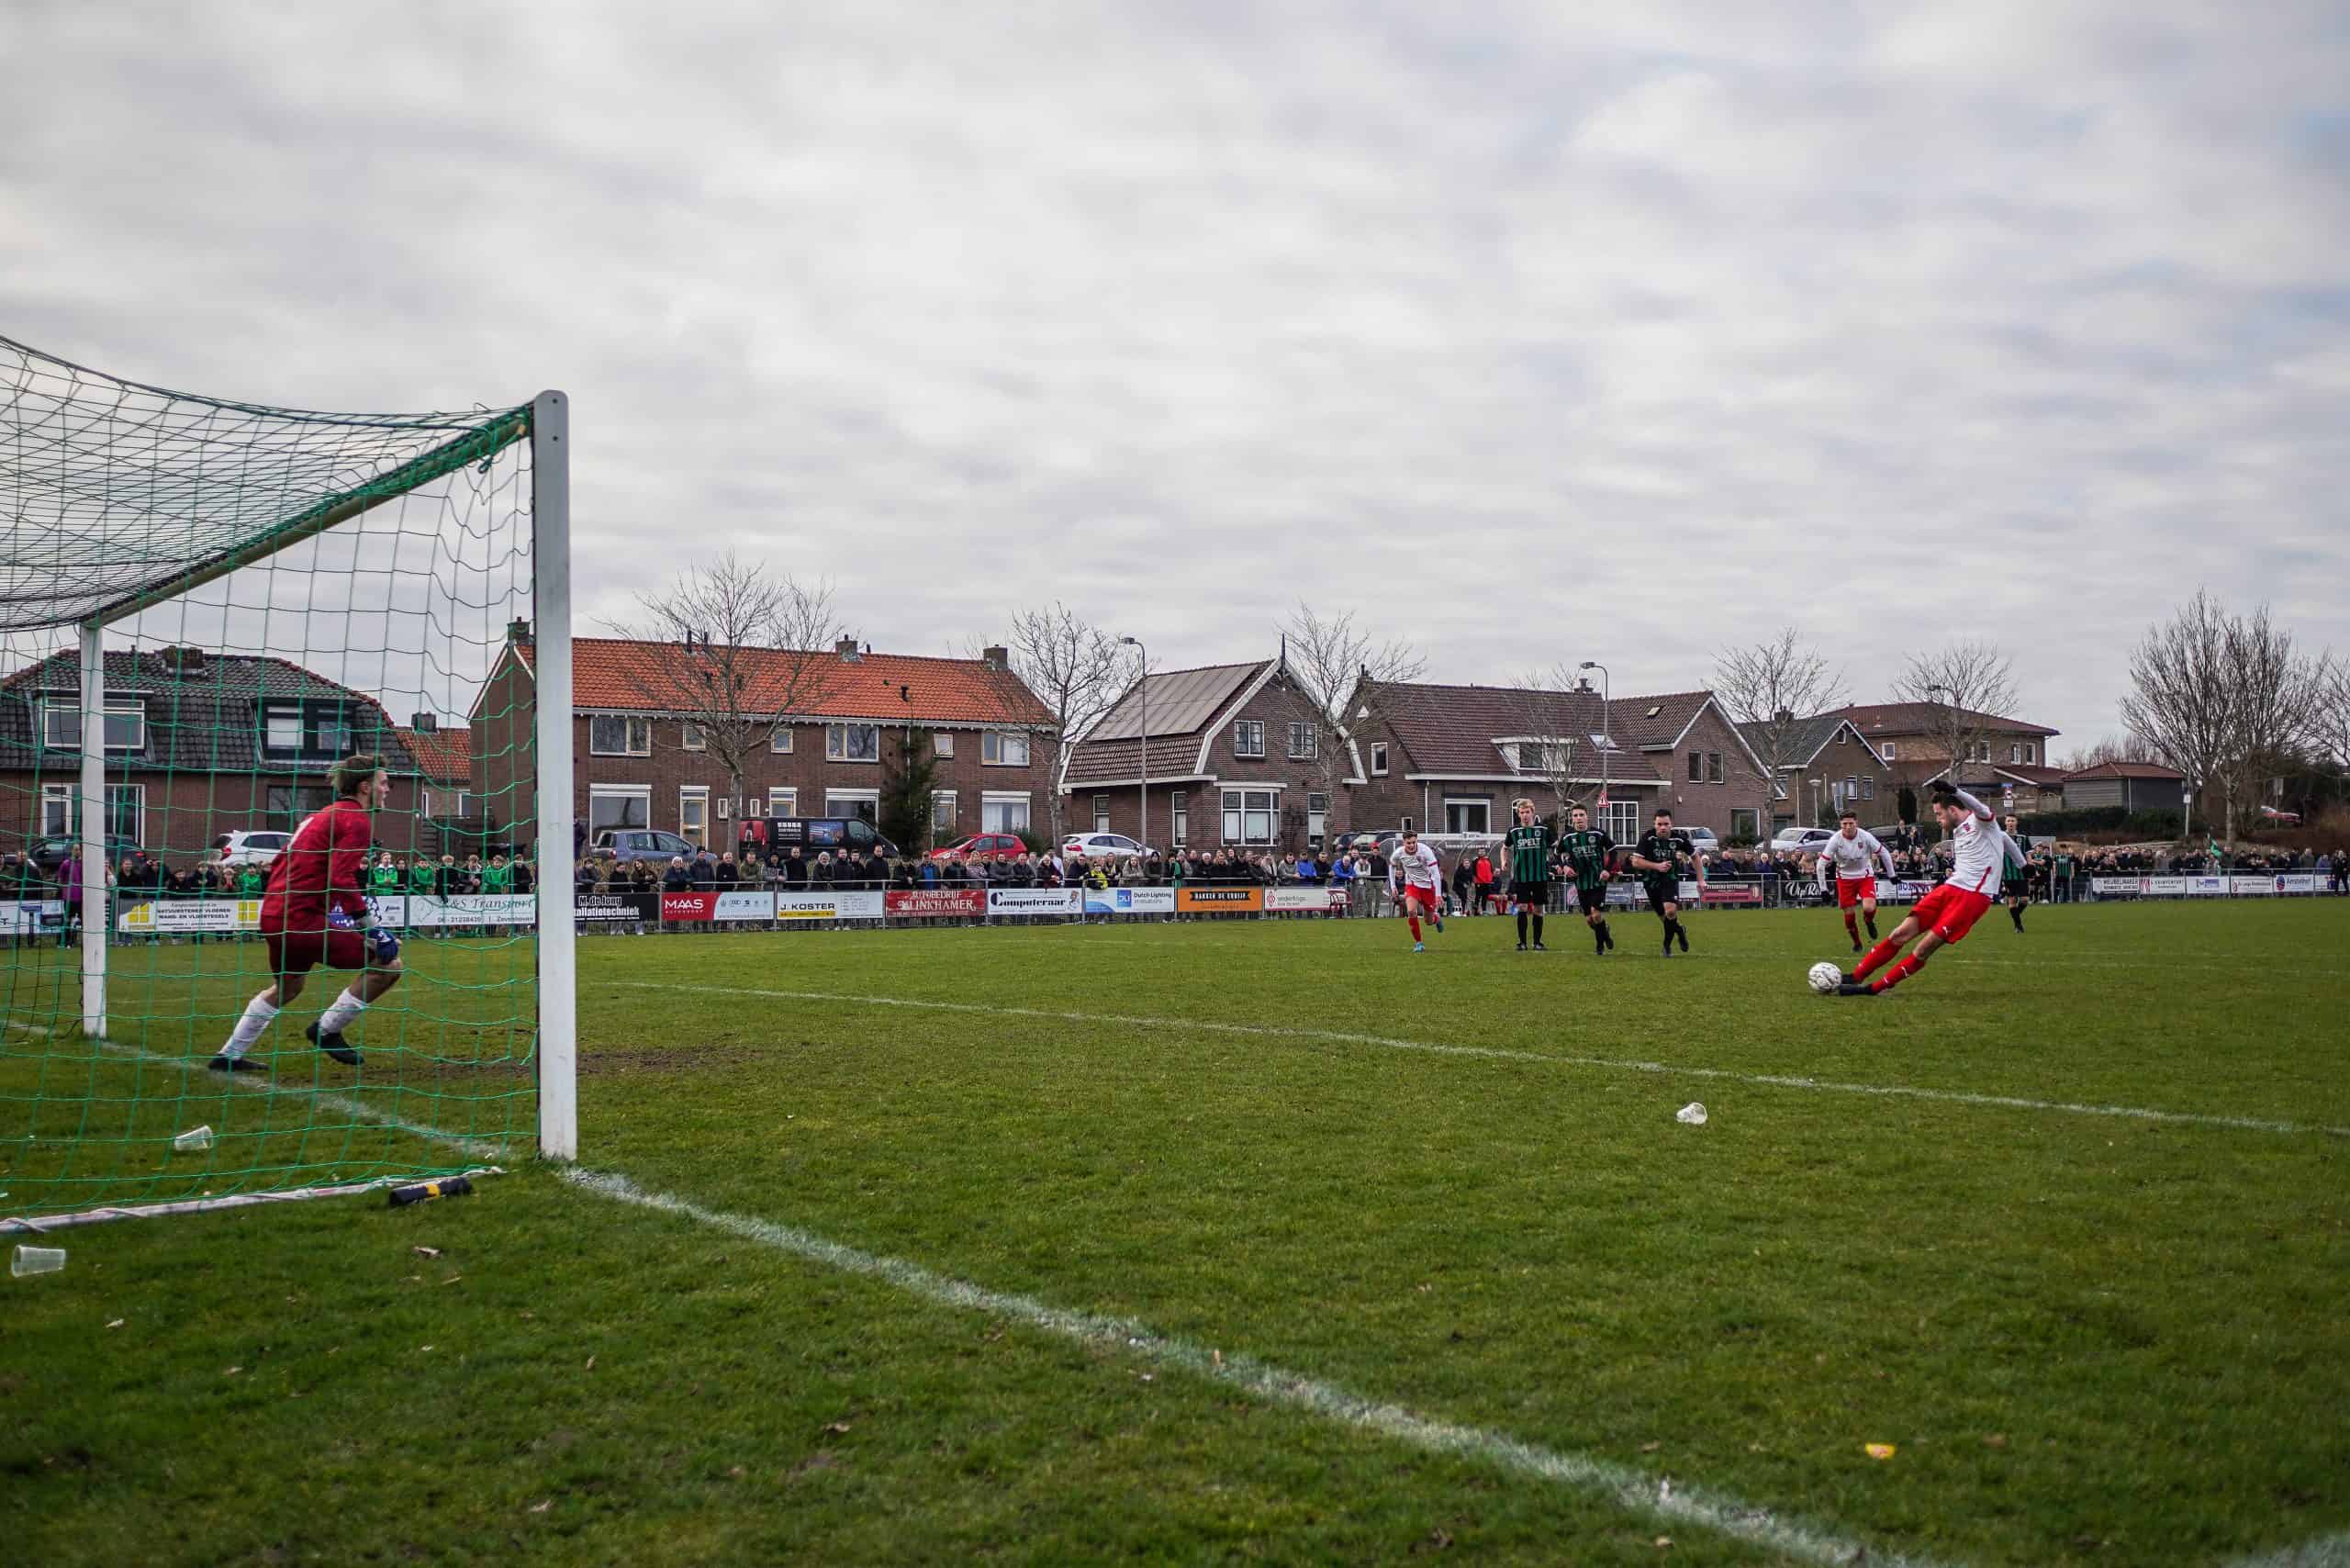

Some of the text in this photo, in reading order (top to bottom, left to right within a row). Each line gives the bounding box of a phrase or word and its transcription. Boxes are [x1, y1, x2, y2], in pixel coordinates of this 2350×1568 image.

[1516, 838, 1541, 846] SPELT
[1150, 891, 1172, 900] Lighting
[665, 899, 704, 910] MAAS
[791, 902, 835, 911] KOSTER
